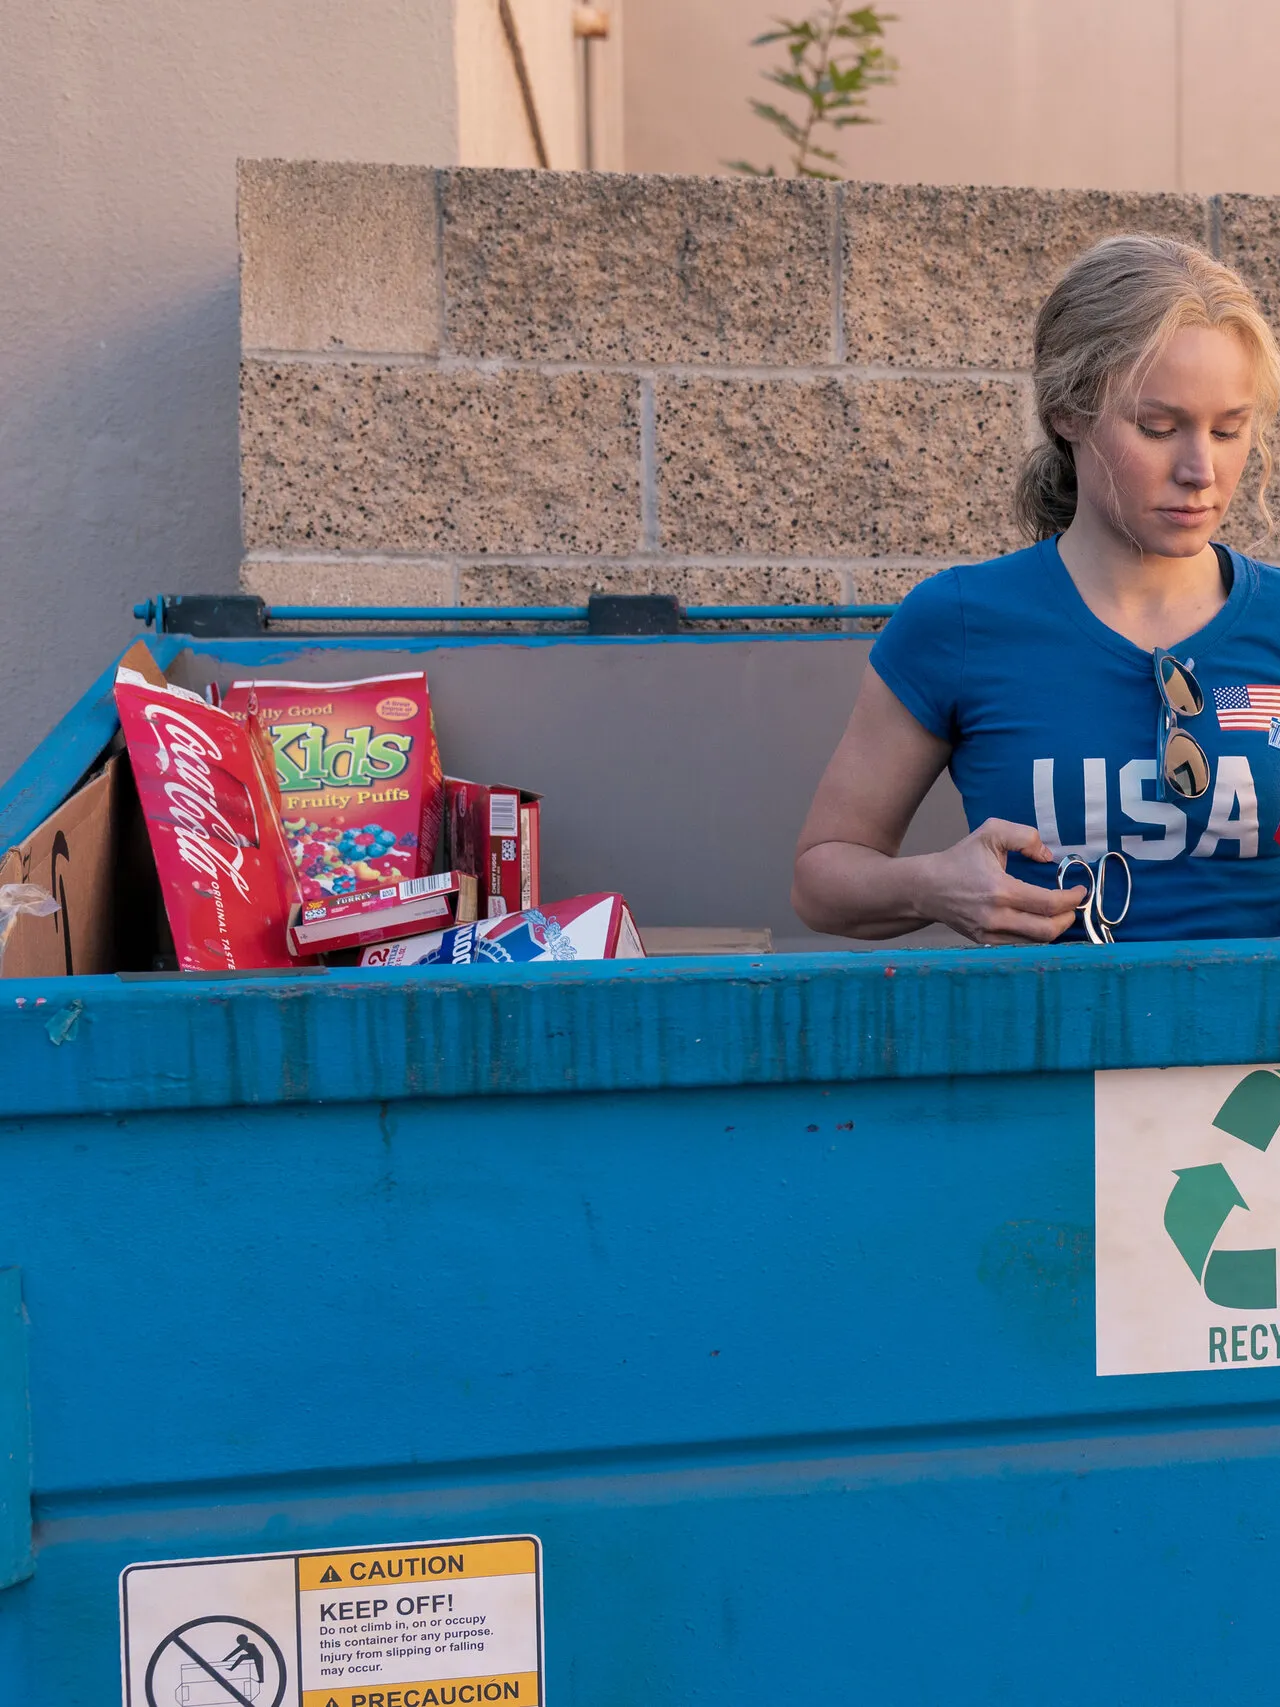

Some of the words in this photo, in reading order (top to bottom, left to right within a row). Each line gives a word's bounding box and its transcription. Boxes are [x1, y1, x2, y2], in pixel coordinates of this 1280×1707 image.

[231, 708, 282, 721] Relly
[288, 704, 333, 717] Good
[269, 722, 413, 792] Kids
[287, 794, 350, 809] Fruity
[357, 788, 410, 805] Puffs
[1033, 756, 1259, 863] USA
[211, 881, 227, 933] ORIGINAL
[221, 938, 236, 970] TASTE
[368, 948, 390, 966] 2
[388, 944, 400, 966] TTLES
[350, 1554, 464, 1580] CAUTION
[320, 1600, 388, 1622] KEEP
[396, 1594, 453, 1616] OFF!
[320, 1626, 335, 1635] Do
[339, 1625, 358, 1634] not
[361, 1621, 392, 1632] climb
[395, 1621, 409, 1630] in,
[412, 1620, 426, 1628] on
[430, 1619, 442, 1627] or
[445, 1615, 486, 1626] occupy
[320, 1639, 341, 1649] this
[344, 1635, 398, 1647] container
[401, 1633, 417, 1642] for
[420, 1632, 440, 1642] any
[444, 1628, 494, 1640] purpose.
[320, 1652, 353, 1663] Injury
[356, 1650, 382, 1660] from
[386, 1645, 431, 1658] slipping
[434, 1645, 446, 1653] or
[449, 1641, 484, 1652] falling
[320, 1667, 344, 1677] may
[348, 1664, 383, 1674] occur.
[351, 1679, 519, 1707] PRECAUCIÓN
